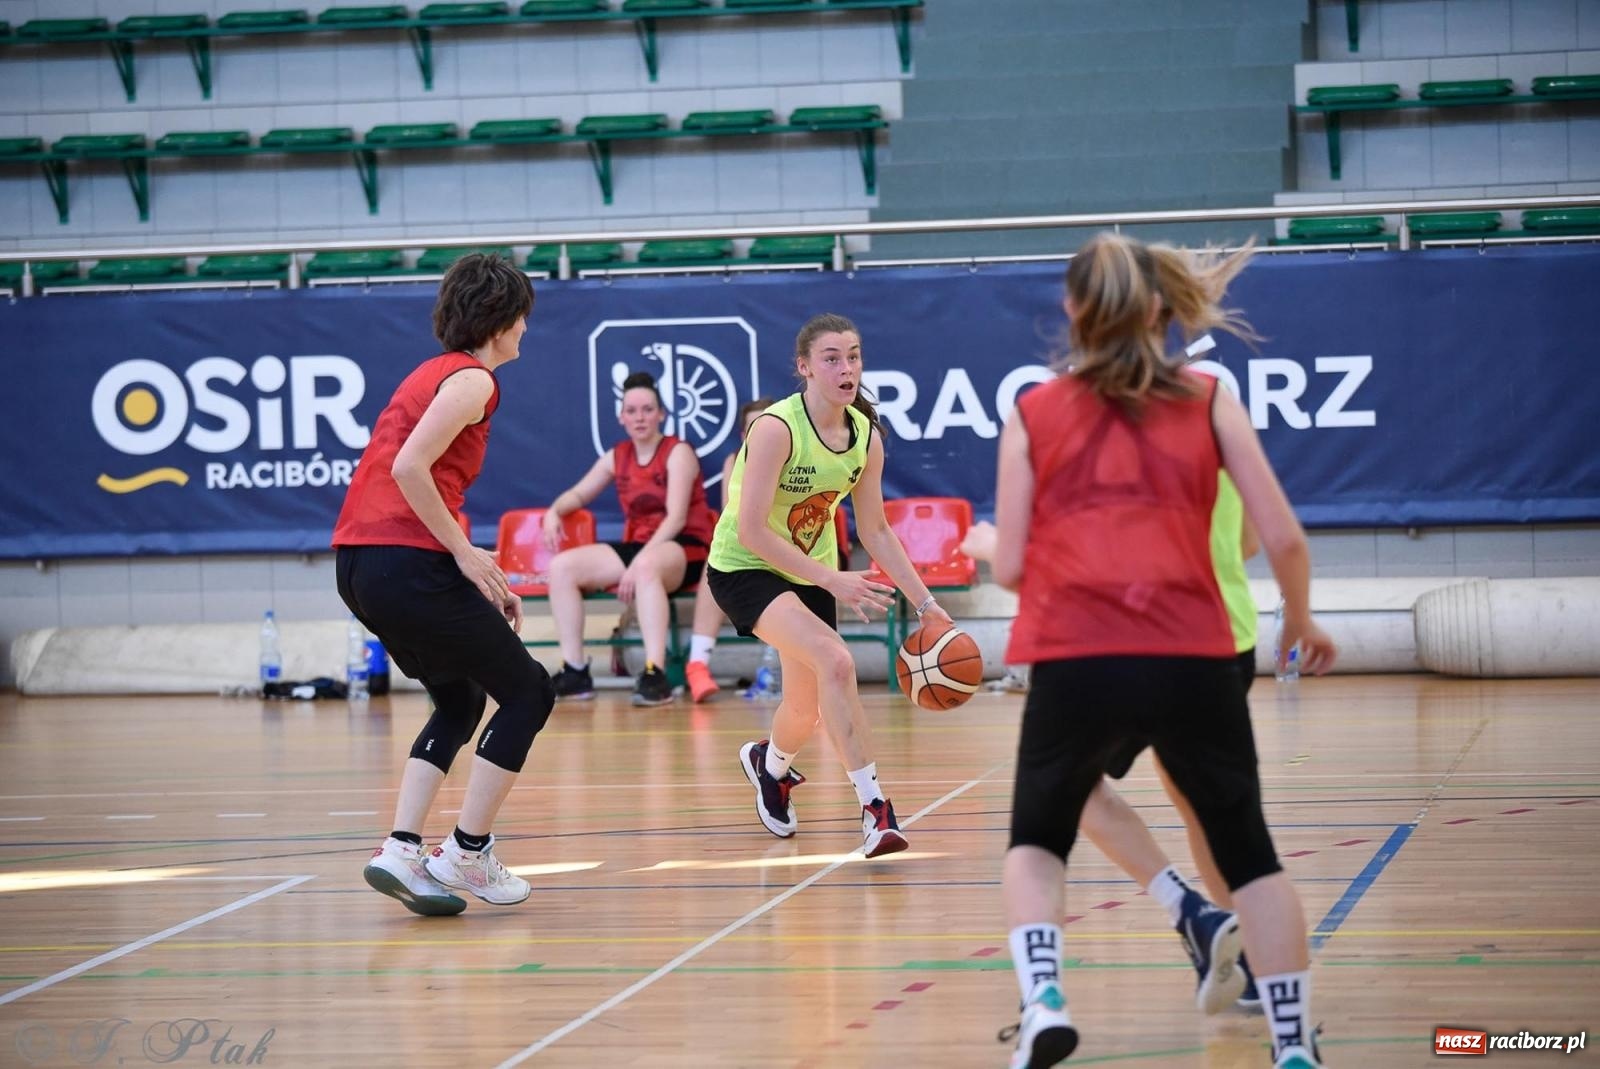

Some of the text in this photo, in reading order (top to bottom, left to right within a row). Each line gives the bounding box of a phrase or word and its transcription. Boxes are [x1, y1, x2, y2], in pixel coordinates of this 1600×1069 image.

[861, 333, 1377, 441] RACÓRZ
[205, 451, 361, 489] RACIBÓR
[788, 476, 810, 485] LIGA
[778, 482, 814, 494] KOBIET
